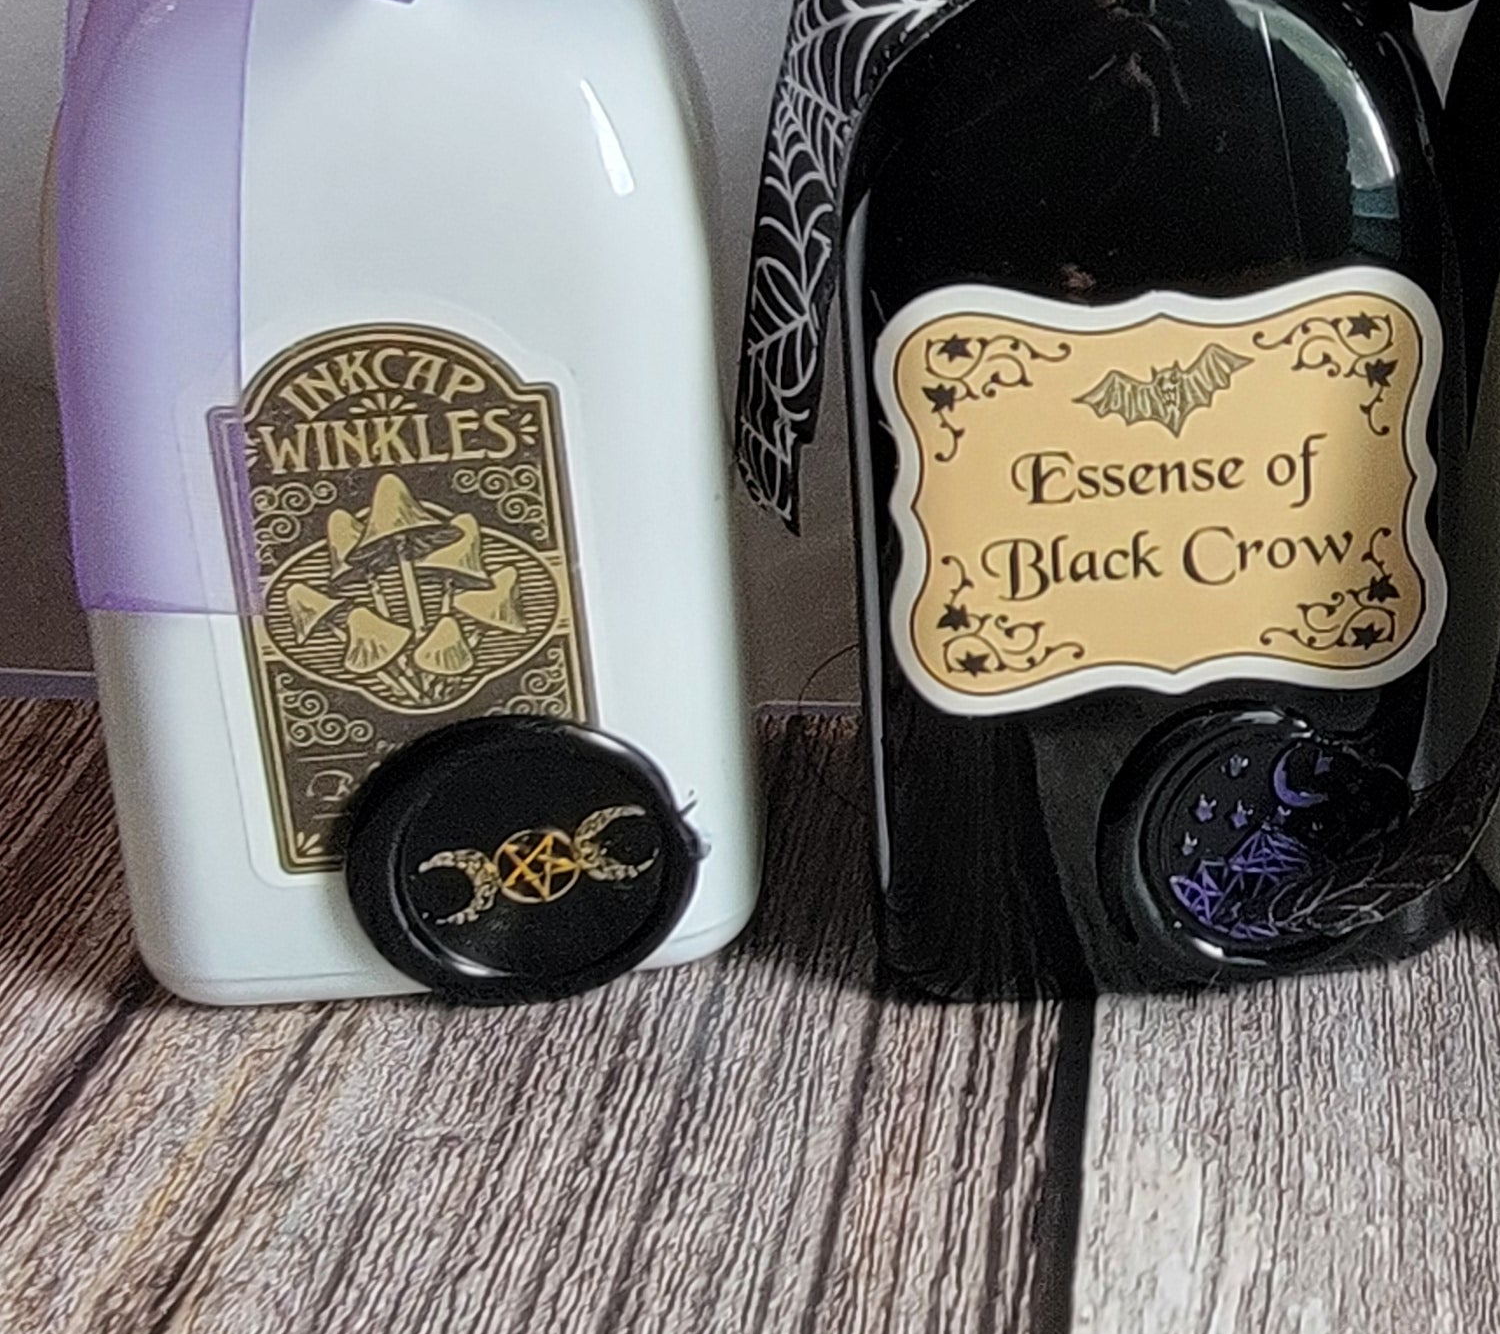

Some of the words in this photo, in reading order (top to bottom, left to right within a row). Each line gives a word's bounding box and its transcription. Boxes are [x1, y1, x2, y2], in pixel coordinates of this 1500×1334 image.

[279, 347, 486, 420] INKCAP
[257, 408, 517, 475] WINKLES
[1011, 449, 1244, 504] Essense
[1266, 433, 1328, 508] of
[980, 530, 1162, 602] Black
[1182, 526, 1354, 586] Crow
